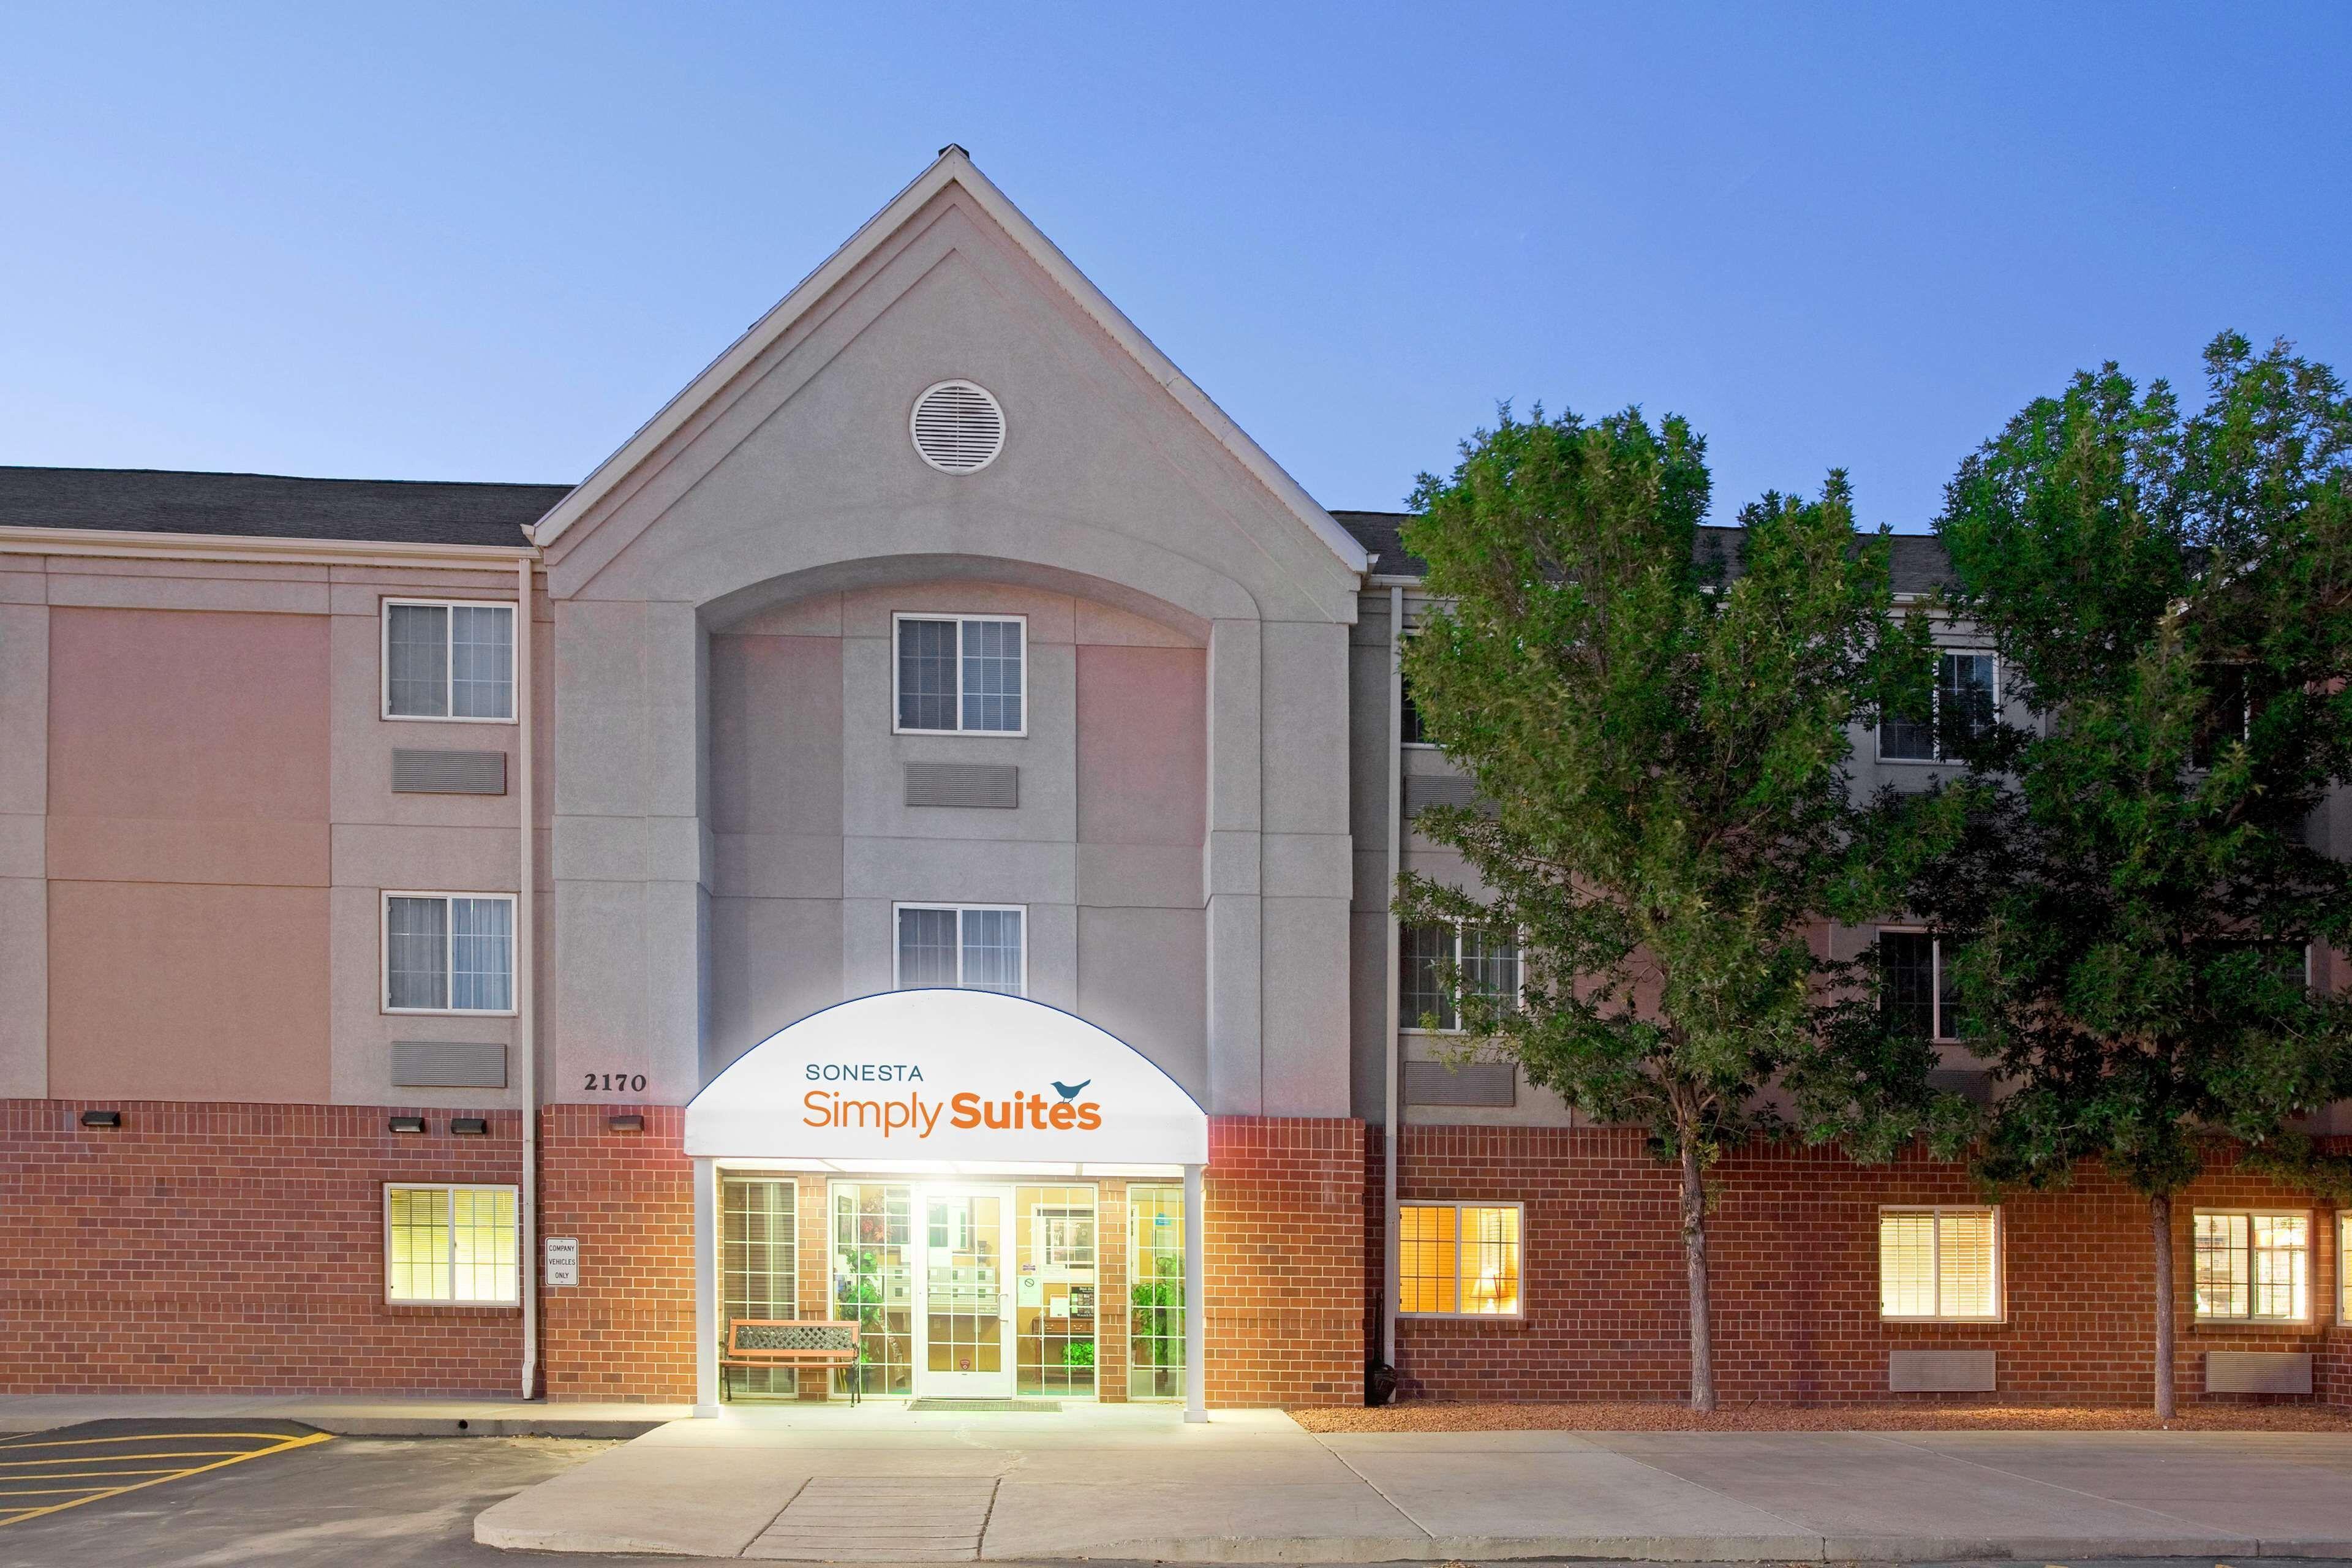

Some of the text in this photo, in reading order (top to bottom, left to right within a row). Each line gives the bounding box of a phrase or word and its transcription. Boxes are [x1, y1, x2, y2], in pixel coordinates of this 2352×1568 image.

[805, 1064, 924, 1082] SONESTA
[584, 1074, 646, 1091] 2170
[803, 1090, 1102, 1139] Simply Suites
